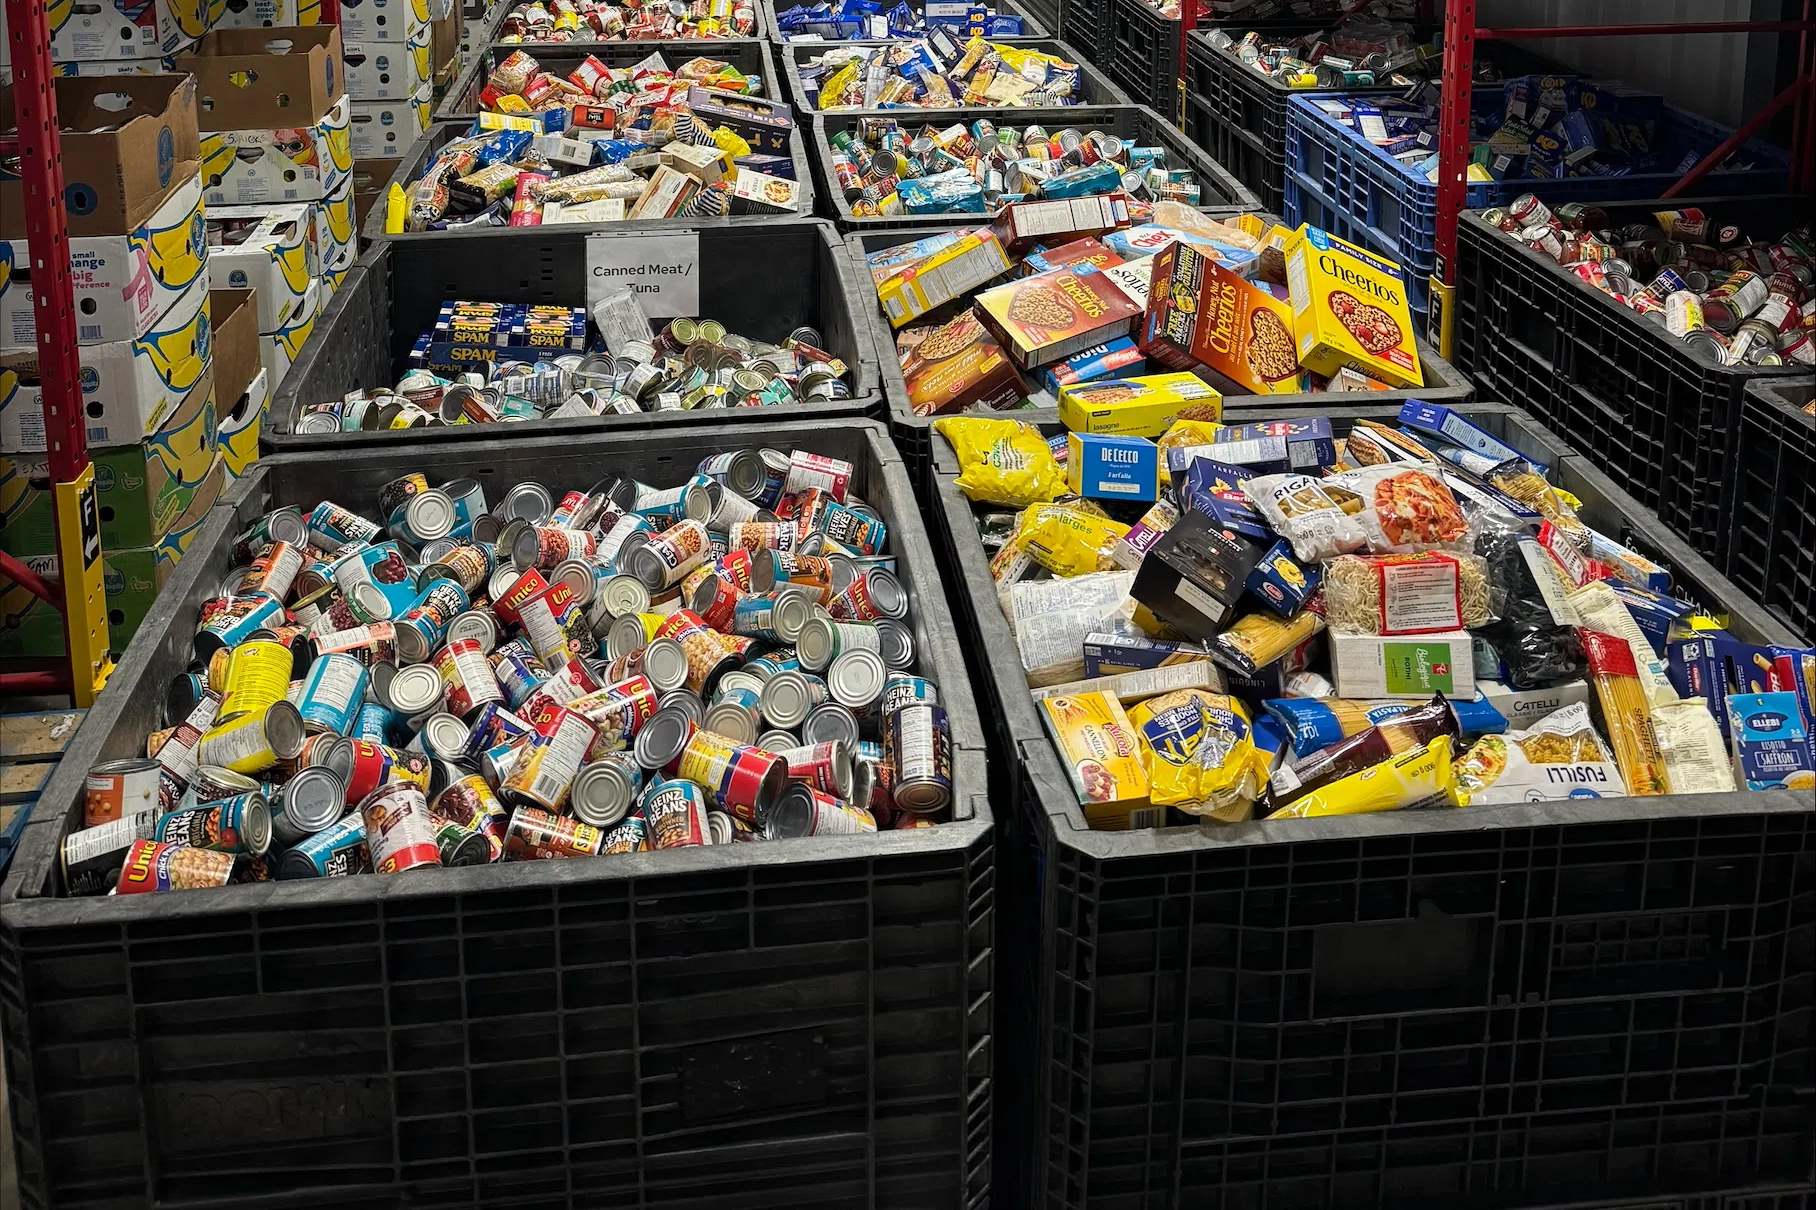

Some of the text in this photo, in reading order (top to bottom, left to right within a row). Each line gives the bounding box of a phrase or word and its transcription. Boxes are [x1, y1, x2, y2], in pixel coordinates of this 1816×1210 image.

[255, 0, 271, 8] best
[1131, 230, 1176, 248] Chex
[1335, 243, 1383, 269] FAMILY SIZE
[1434, 258, 1445, 278] E
[73, 271, 93, 282] big
[593, 265, 646, 277] Canned
[649, 263, 682, 276] Meat
[1319, 255, 1400, 307] Cheerios
[627, 283, 660, 293] Tuna
[1056, 274, 1104, 318] Cheerios
[1083, 285, 1110, 311] Honey Nut
[1206, 279, 1221, 320] Honey Nut
[1209, 281, 1237, 355] Cheerios
[1431, 300, 1441, 319] F
[1166, 309, 1179, 337] FREE
[1174, 311, 1187, 343] SNACKS
[453, 332, 490, 343] SPAM
[529, 335, 565, 347] SPAM
[450, 347, 497, 362] SPAM
[1346, 359, 1386, 383] Cheerios
[1101, 447, 1139, 464] DE CECCO
[1107, 471, 1132, 480] Farfalle
[83, 495, 93, 527] F
[828, 510, 843, 537] HEINZ
[1059, 512, 1093, 535] larges
[1129, 527, 1154, 554] CATELLI
[430, 590, 459, 617] BEANS
[439, 578, 463, 605] HEINZ
[504, 578, 539, 611] Unico
[854, 581, 873, 621] Unico
[1404, 656, 1412, 680] ROTINI
[1416, 646, 1431, 689] Biologique
[886, 685, 912, 704] HEINZ
[1514, 699, 1561, 712] CATELLI
[1752, 718, 1780, 728] ELLEBI
[1084, 724, 1108, 762] CANNELLONI
[1104, 723, 1130, 757] Aurora
[1634, 707, 1656, 766] SPAGHETTI
[1761, 741, 1786, 750] RISOTTO
[1760, 752, 1795, 766] SAFFRON
[1546, 766, 1607, 783] FUSILLI
[650, 791, 682, 813] HEINZ
[650, 800, 688, 827] BEANS
[602, 834, 640, 854] BEANS
[605, 826, 634, 842] HEINZ
[129, 840, 158, 882] Unico
[159, 856, 168, 880] Chick
